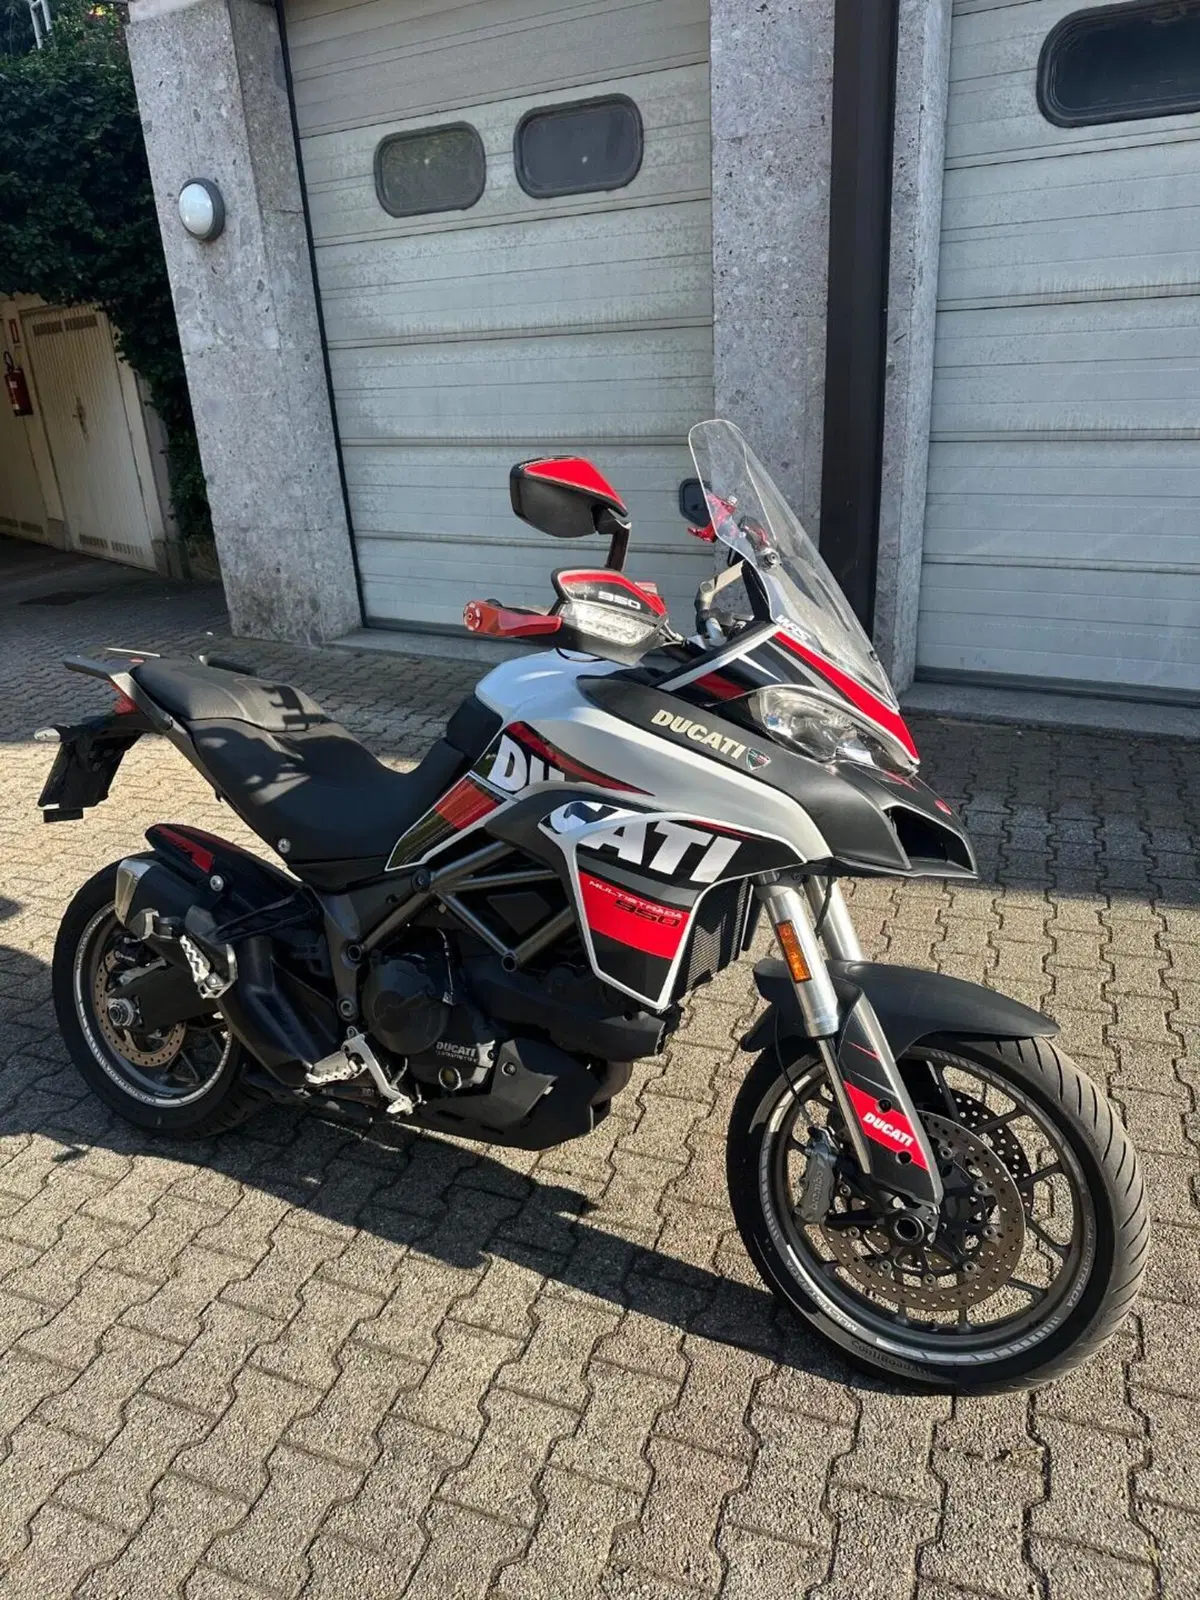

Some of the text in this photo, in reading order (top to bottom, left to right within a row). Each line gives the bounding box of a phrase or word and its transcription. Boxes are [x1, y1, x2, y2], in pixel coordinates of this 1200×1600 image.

[598, 591, 641, 609] 950
[651, 708, 747, 760] DUCATI
[588, 880, 682, 919] MULTISTRADA
[614, 899, 681, 928] 950
[436, 1041, 476, 1058] DUCATI
[862, 1111, 914, 1147] DUCATI
[809, 1170, 824, 1211] brembo
[787, 1259, 858, 1333] MULTISTRADA
